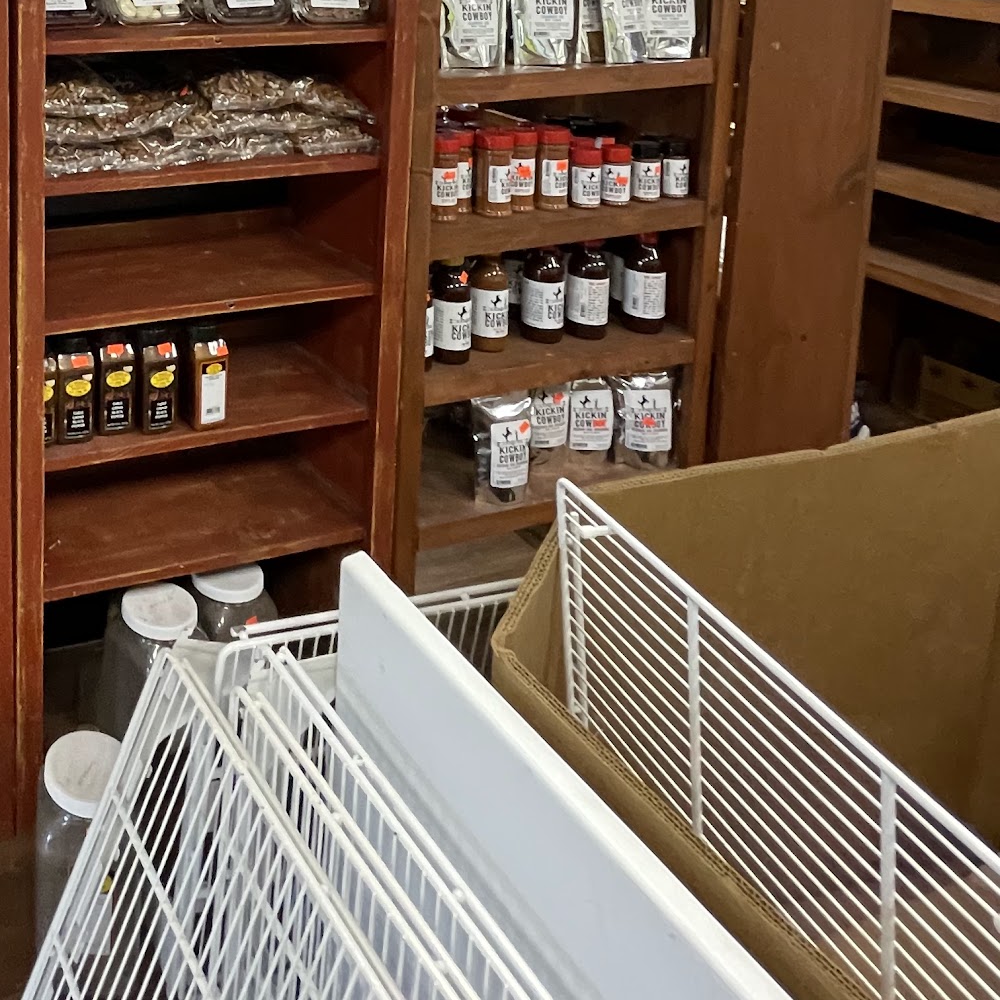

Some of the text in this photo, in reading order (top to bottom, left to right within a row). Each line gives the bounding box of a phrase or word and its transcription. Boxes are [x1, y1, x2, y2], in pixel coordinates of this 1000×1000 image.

[462, 4, 492, 12] KICKIN
[536, 6, 568, 15] COWBOY
[652, 5, 687, 13] COWBOY
[462, 12, 492, 21] COWBOY
[535, 407, 565, 416] KICKIN
[536, 414, 565, 425] COWBOY
[634, 420, 666, 428] COOY
[499, 445, 527, 454] KICKIN
[499, 453, 527, 463] COWBOY
